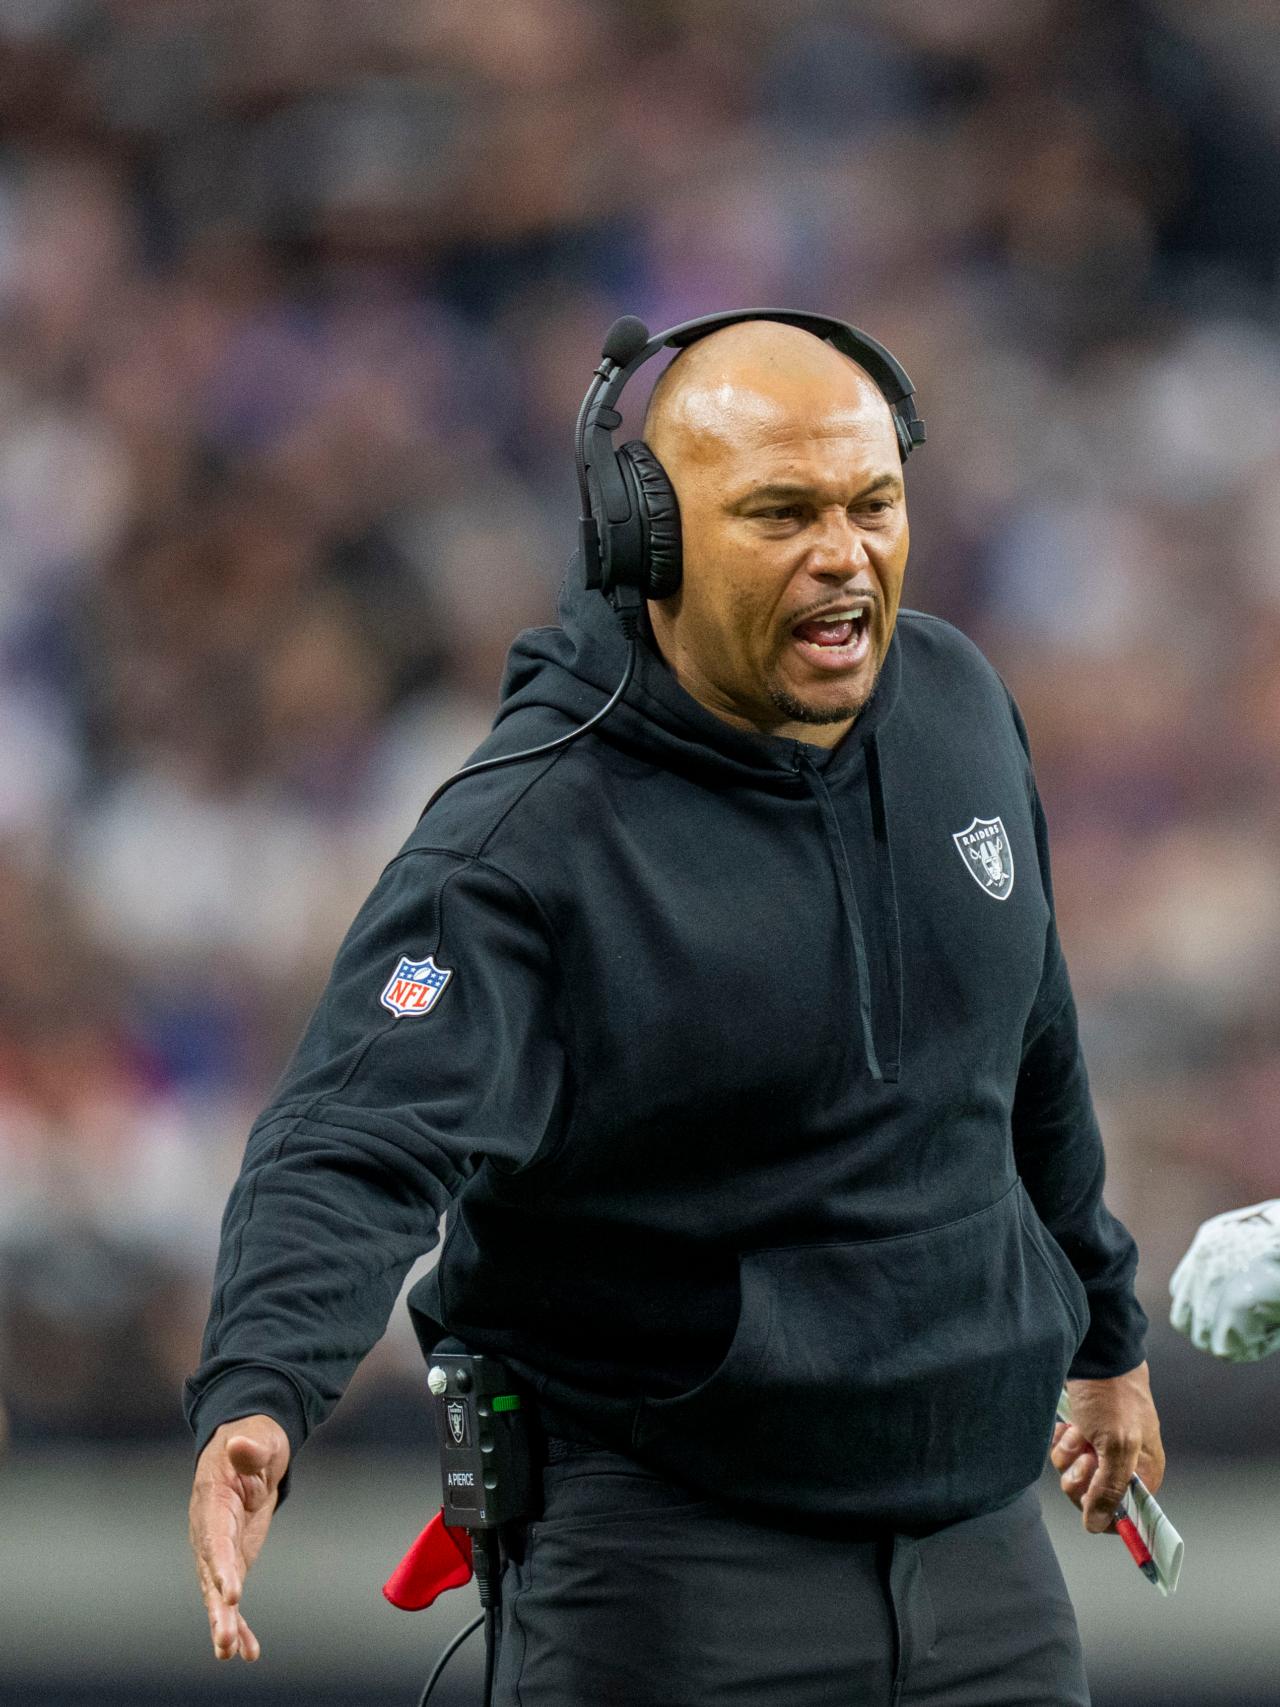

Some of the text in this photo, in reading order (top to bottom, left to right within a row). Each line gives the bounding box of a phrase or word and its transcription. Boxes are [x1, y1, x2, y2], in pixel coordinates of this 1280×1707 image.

[962, 824, 1000, 846] RAIDERS
[388, 979, 430, 1008] NFL
[453, 1473, 475, 1486] PIERCE
